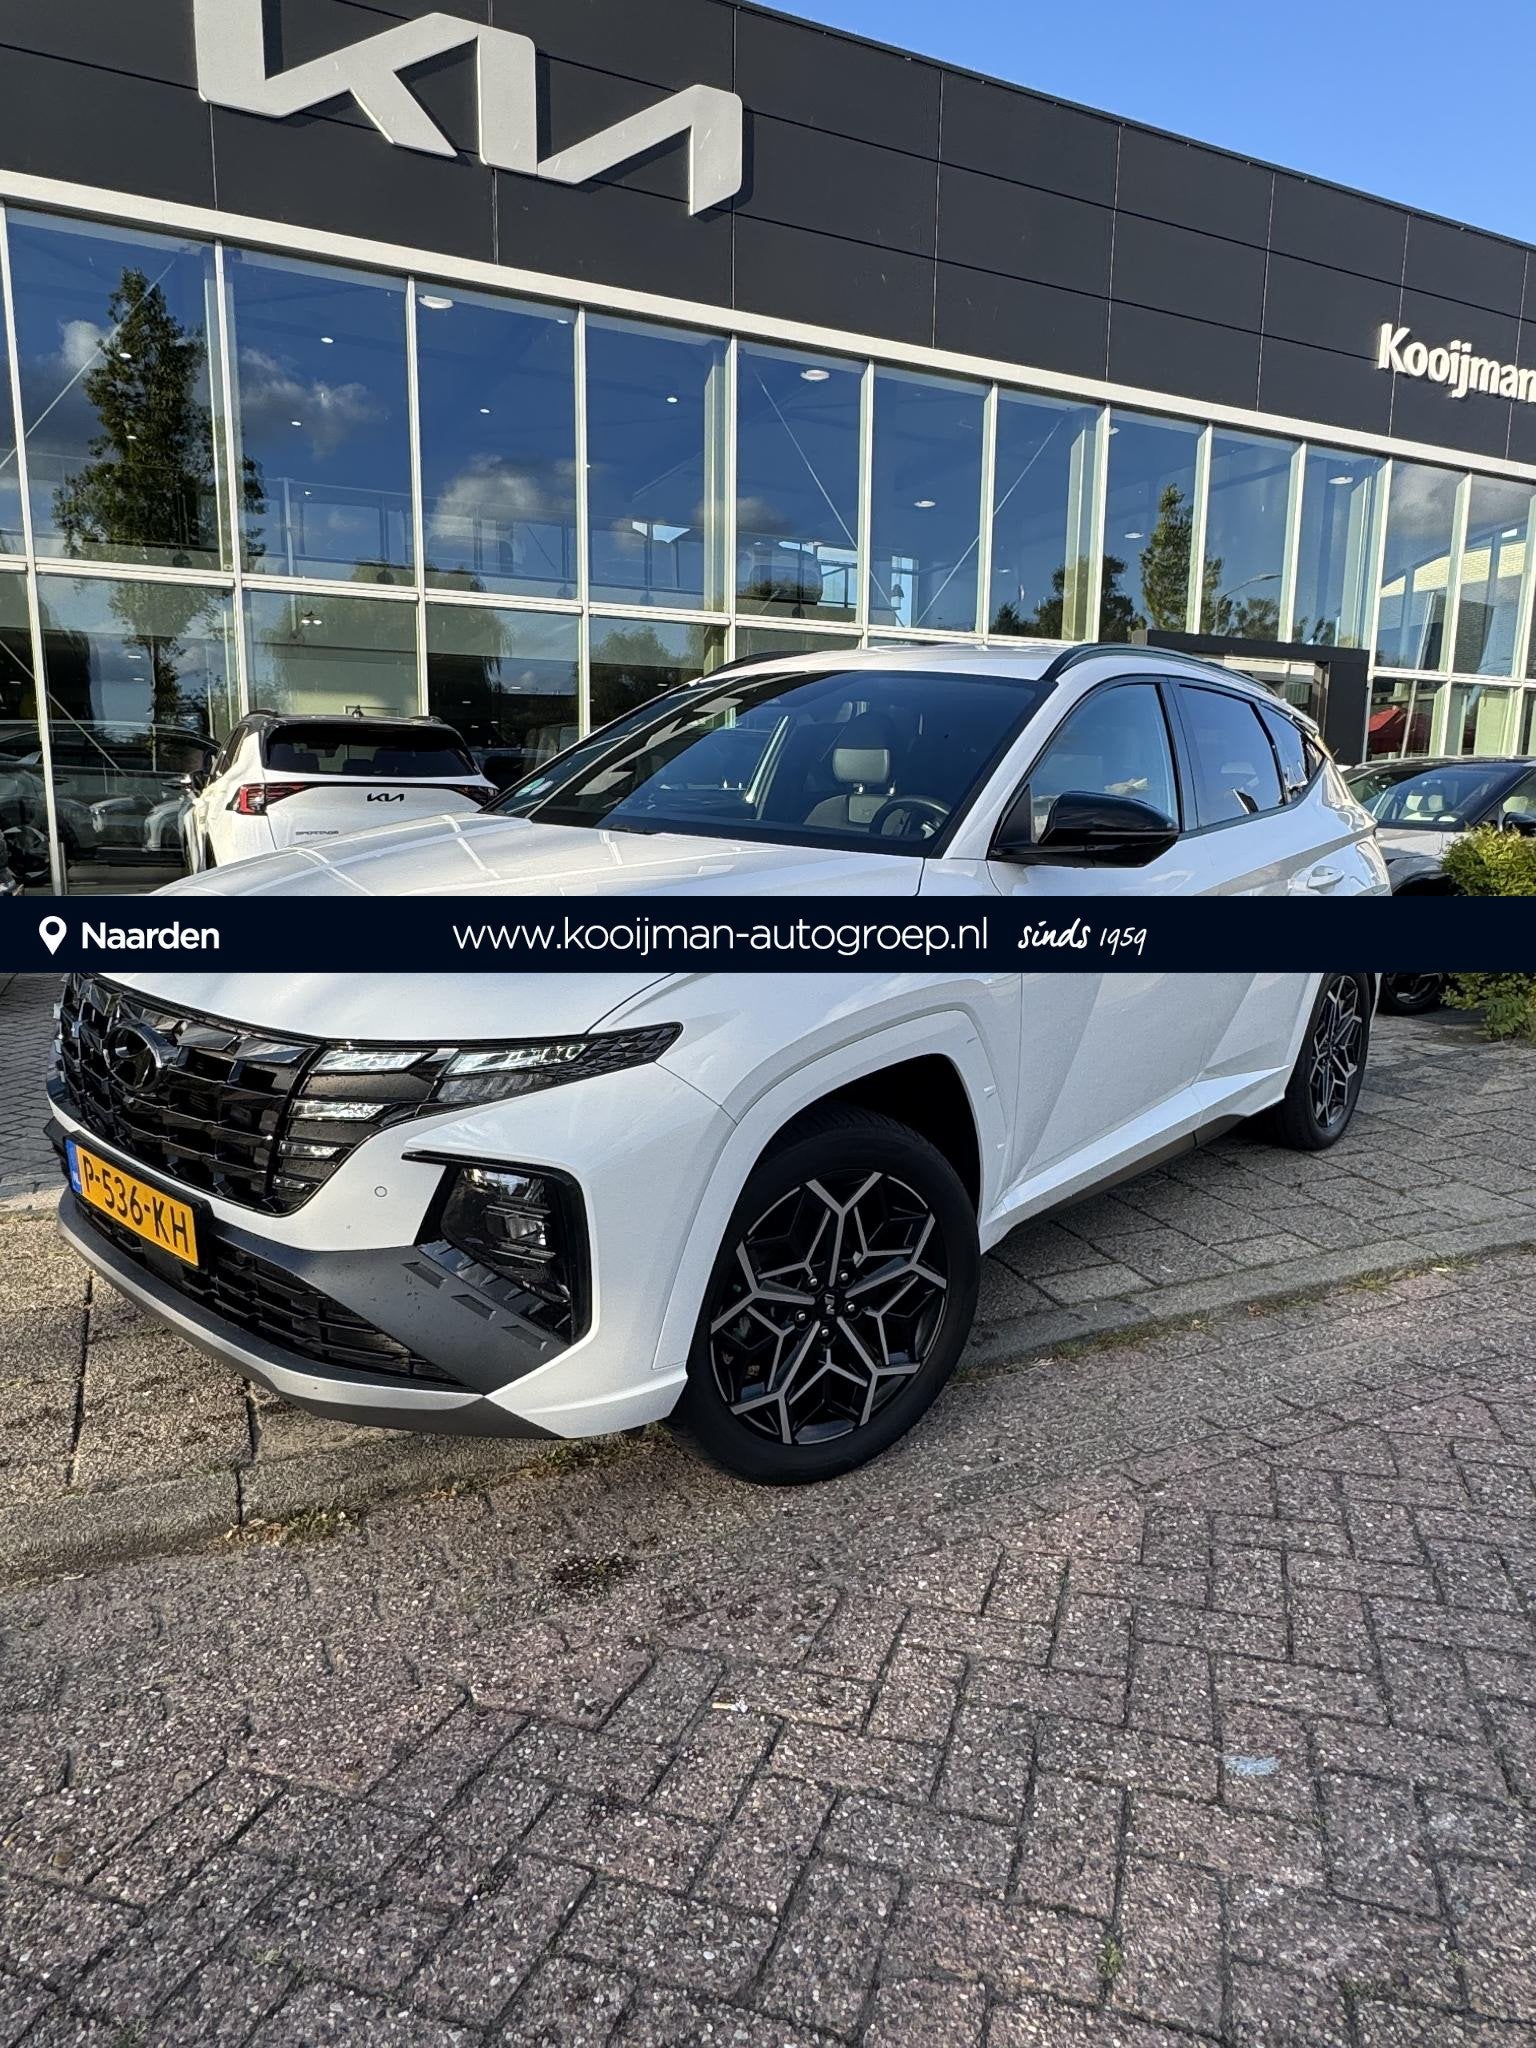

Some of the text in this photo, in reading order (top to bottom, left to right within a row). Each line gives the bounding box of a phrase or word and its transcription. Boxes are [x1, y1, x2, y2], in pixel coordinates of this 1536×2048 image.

[193, 0, 743, 217] KIA
[1377, 322, 1536, 403] Kooijman
[82, 1155, 190, 1254] P-536-KH
